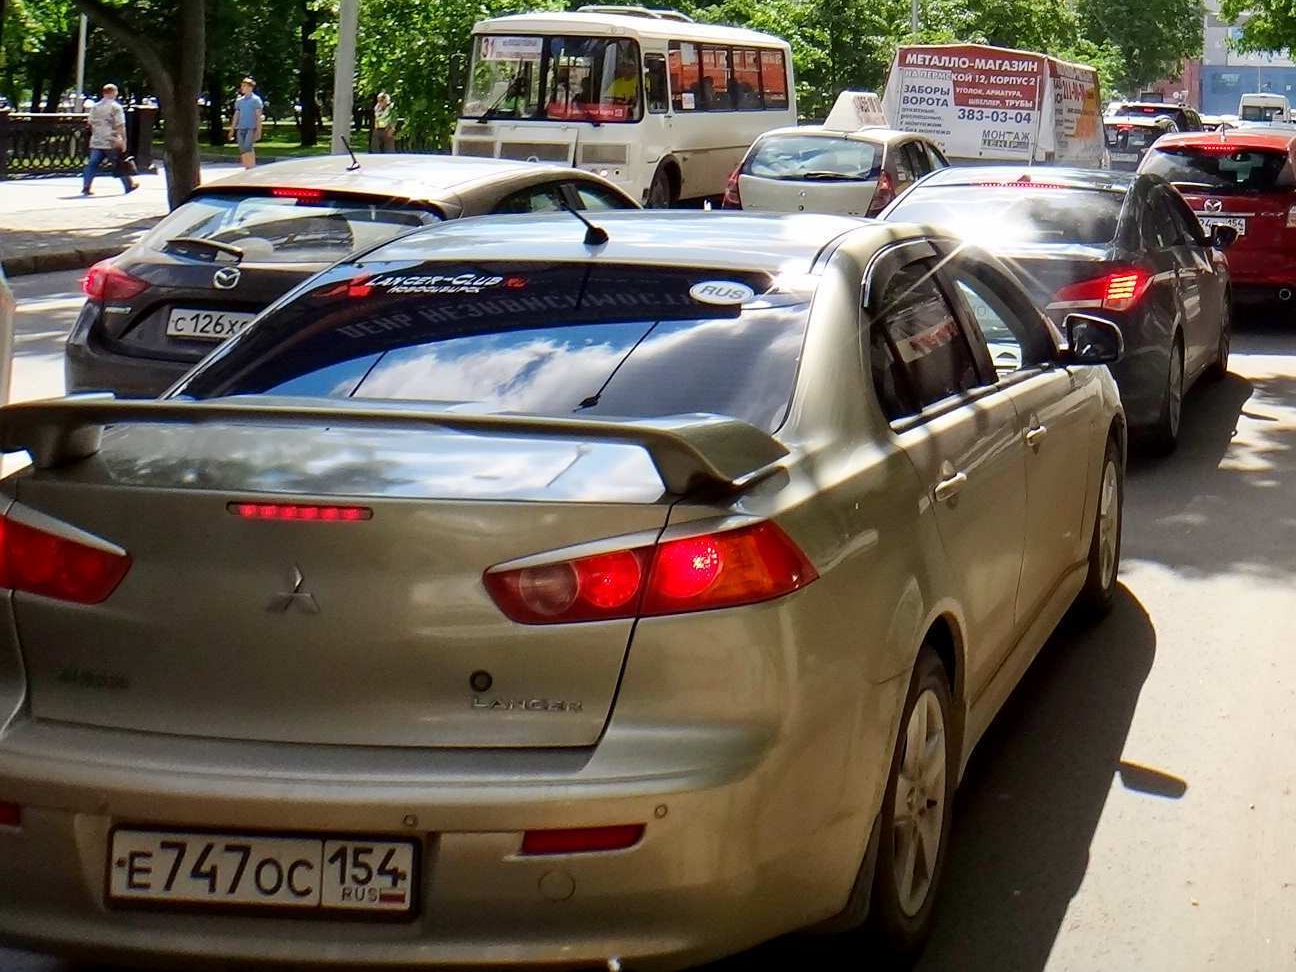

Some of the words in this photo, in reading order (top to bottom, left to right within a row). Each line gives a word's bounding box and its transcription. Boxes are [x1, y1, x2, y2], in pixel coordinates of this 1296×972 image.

[905, 53, 1038, 73] МЕТАЛЛО-МАГАЗИН
[905, 70, 918, 78] НА
[920, 70, 972, 82] ПЕРМСКОЙ
[975, 74, 988, 85] 12,
[990, 76, 1028, 86] КОРПУС
[1028, 77, 1036, 86] 2
[904, 84, 950, 96] ЗАБОРЫ
[902, 96, 949, 108] ВОРОТА
[1005, 99, 1033, 108] ТРУБЫ
[958, 108, 1032, 124] 383-03-04
[982, 129, 1031, 141] МОНТАЖ
[700, 285, 746, 299] RUS
[174, 313, 248, 336] С126Х
[472, 697, 583, 712] LANCER
[126, 840, 315, 898] Е747ОС
[327, 845, 399, 888] 154
[341, 888, 378, 902] RUS
